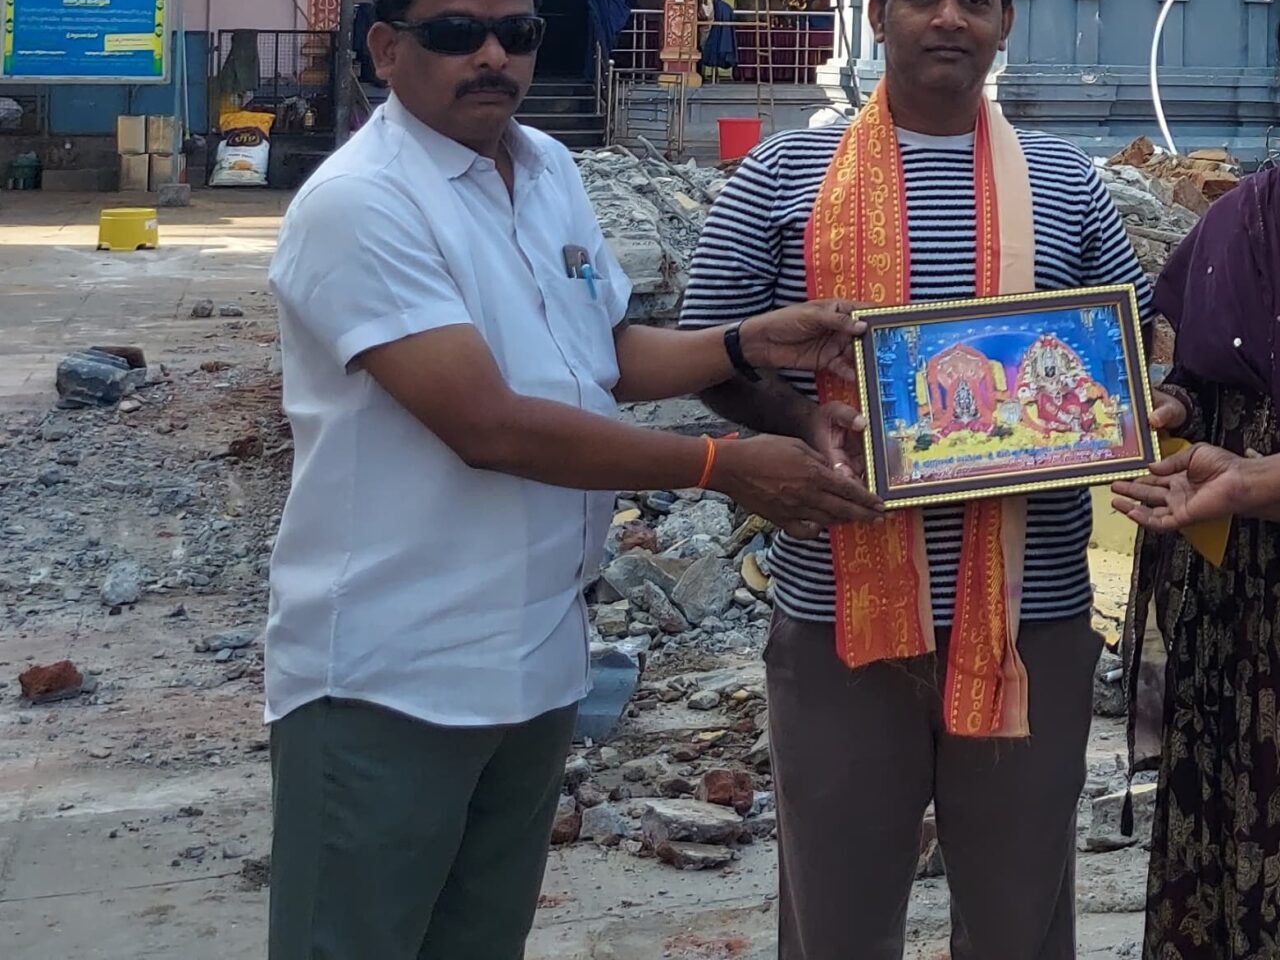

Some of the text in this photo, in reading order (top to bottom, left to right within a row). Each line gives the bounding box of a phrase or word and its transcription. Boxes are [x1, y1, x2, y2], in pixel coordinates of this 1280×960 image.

[865, 104, 887, 158] స్వామి
[824, 187, 846, 250] స్వామి
[866, 162, 890, 247] వీరేశ్వర
[867, 251, 891, 277] శ్రీ
